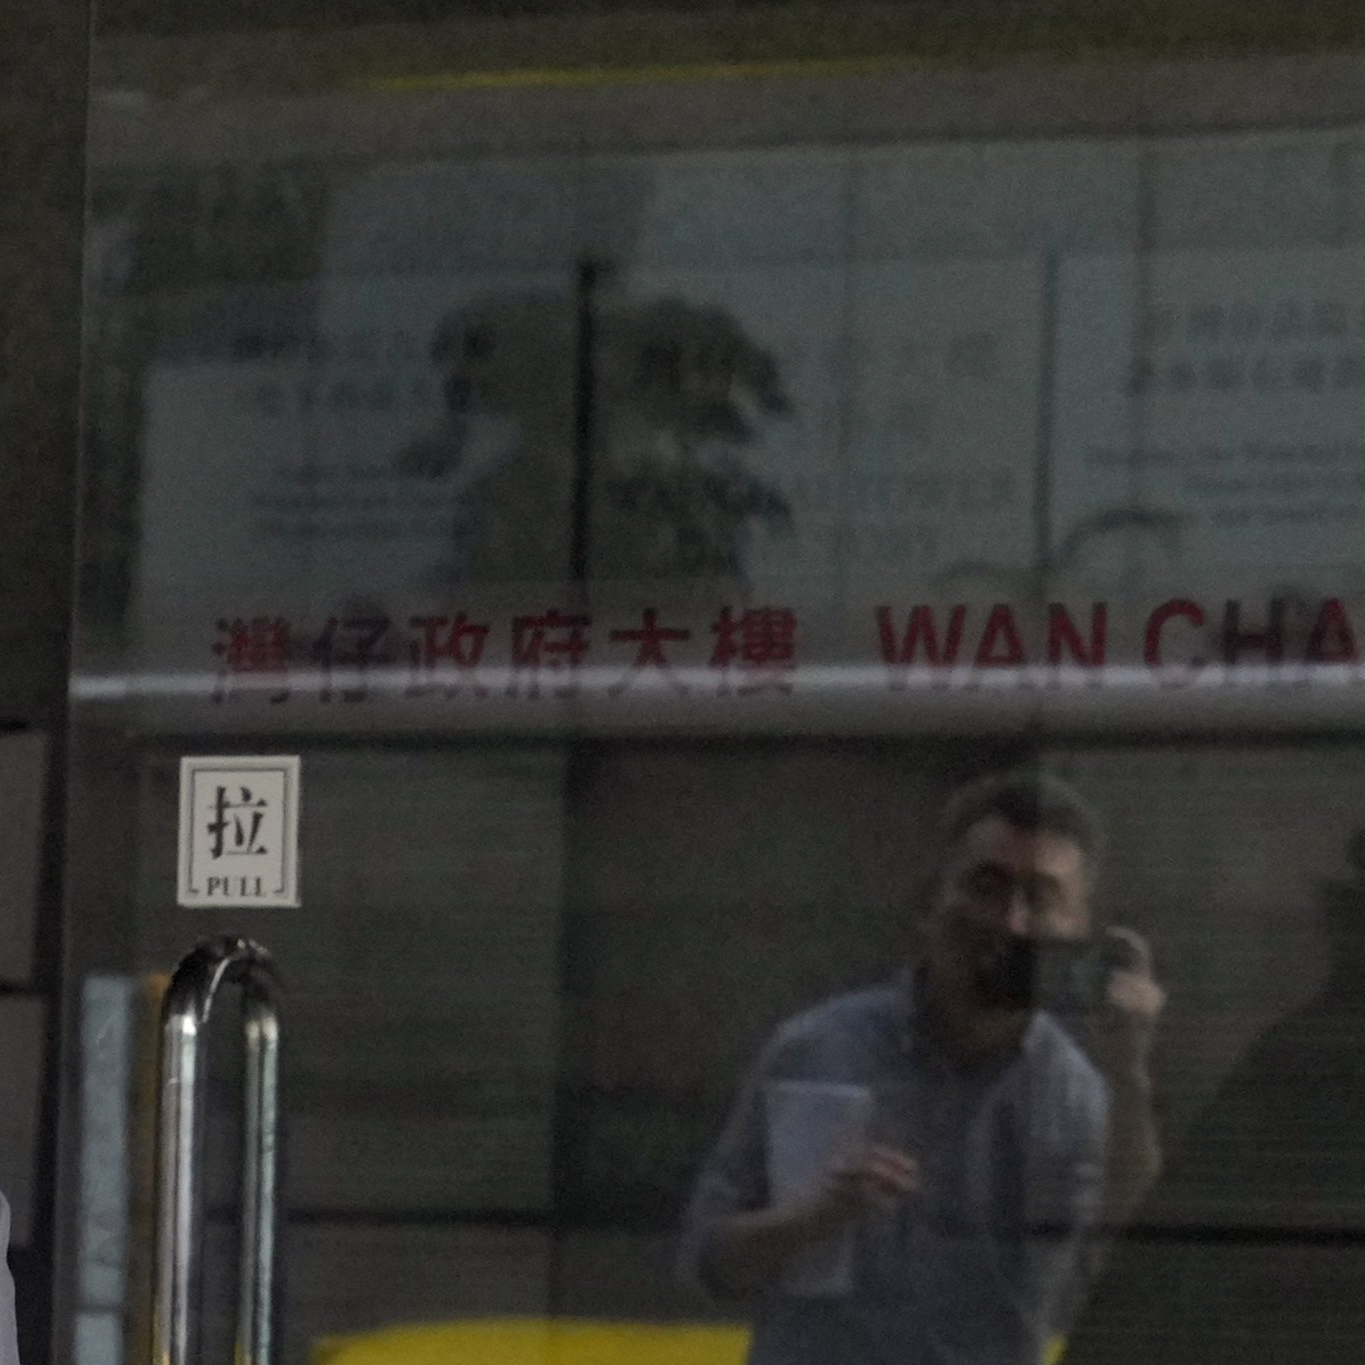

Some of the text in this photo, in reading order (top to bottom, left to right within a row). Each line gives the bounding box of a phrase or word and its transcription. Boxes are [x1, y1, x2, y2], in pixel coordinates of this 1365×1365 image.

[211, 606, 798, 702] 灣仔政府大樓
[876, 603, 1108, 691] WAN
[207, 786, 268, 859] 拉
[206, 876, 267, 897] PULL
